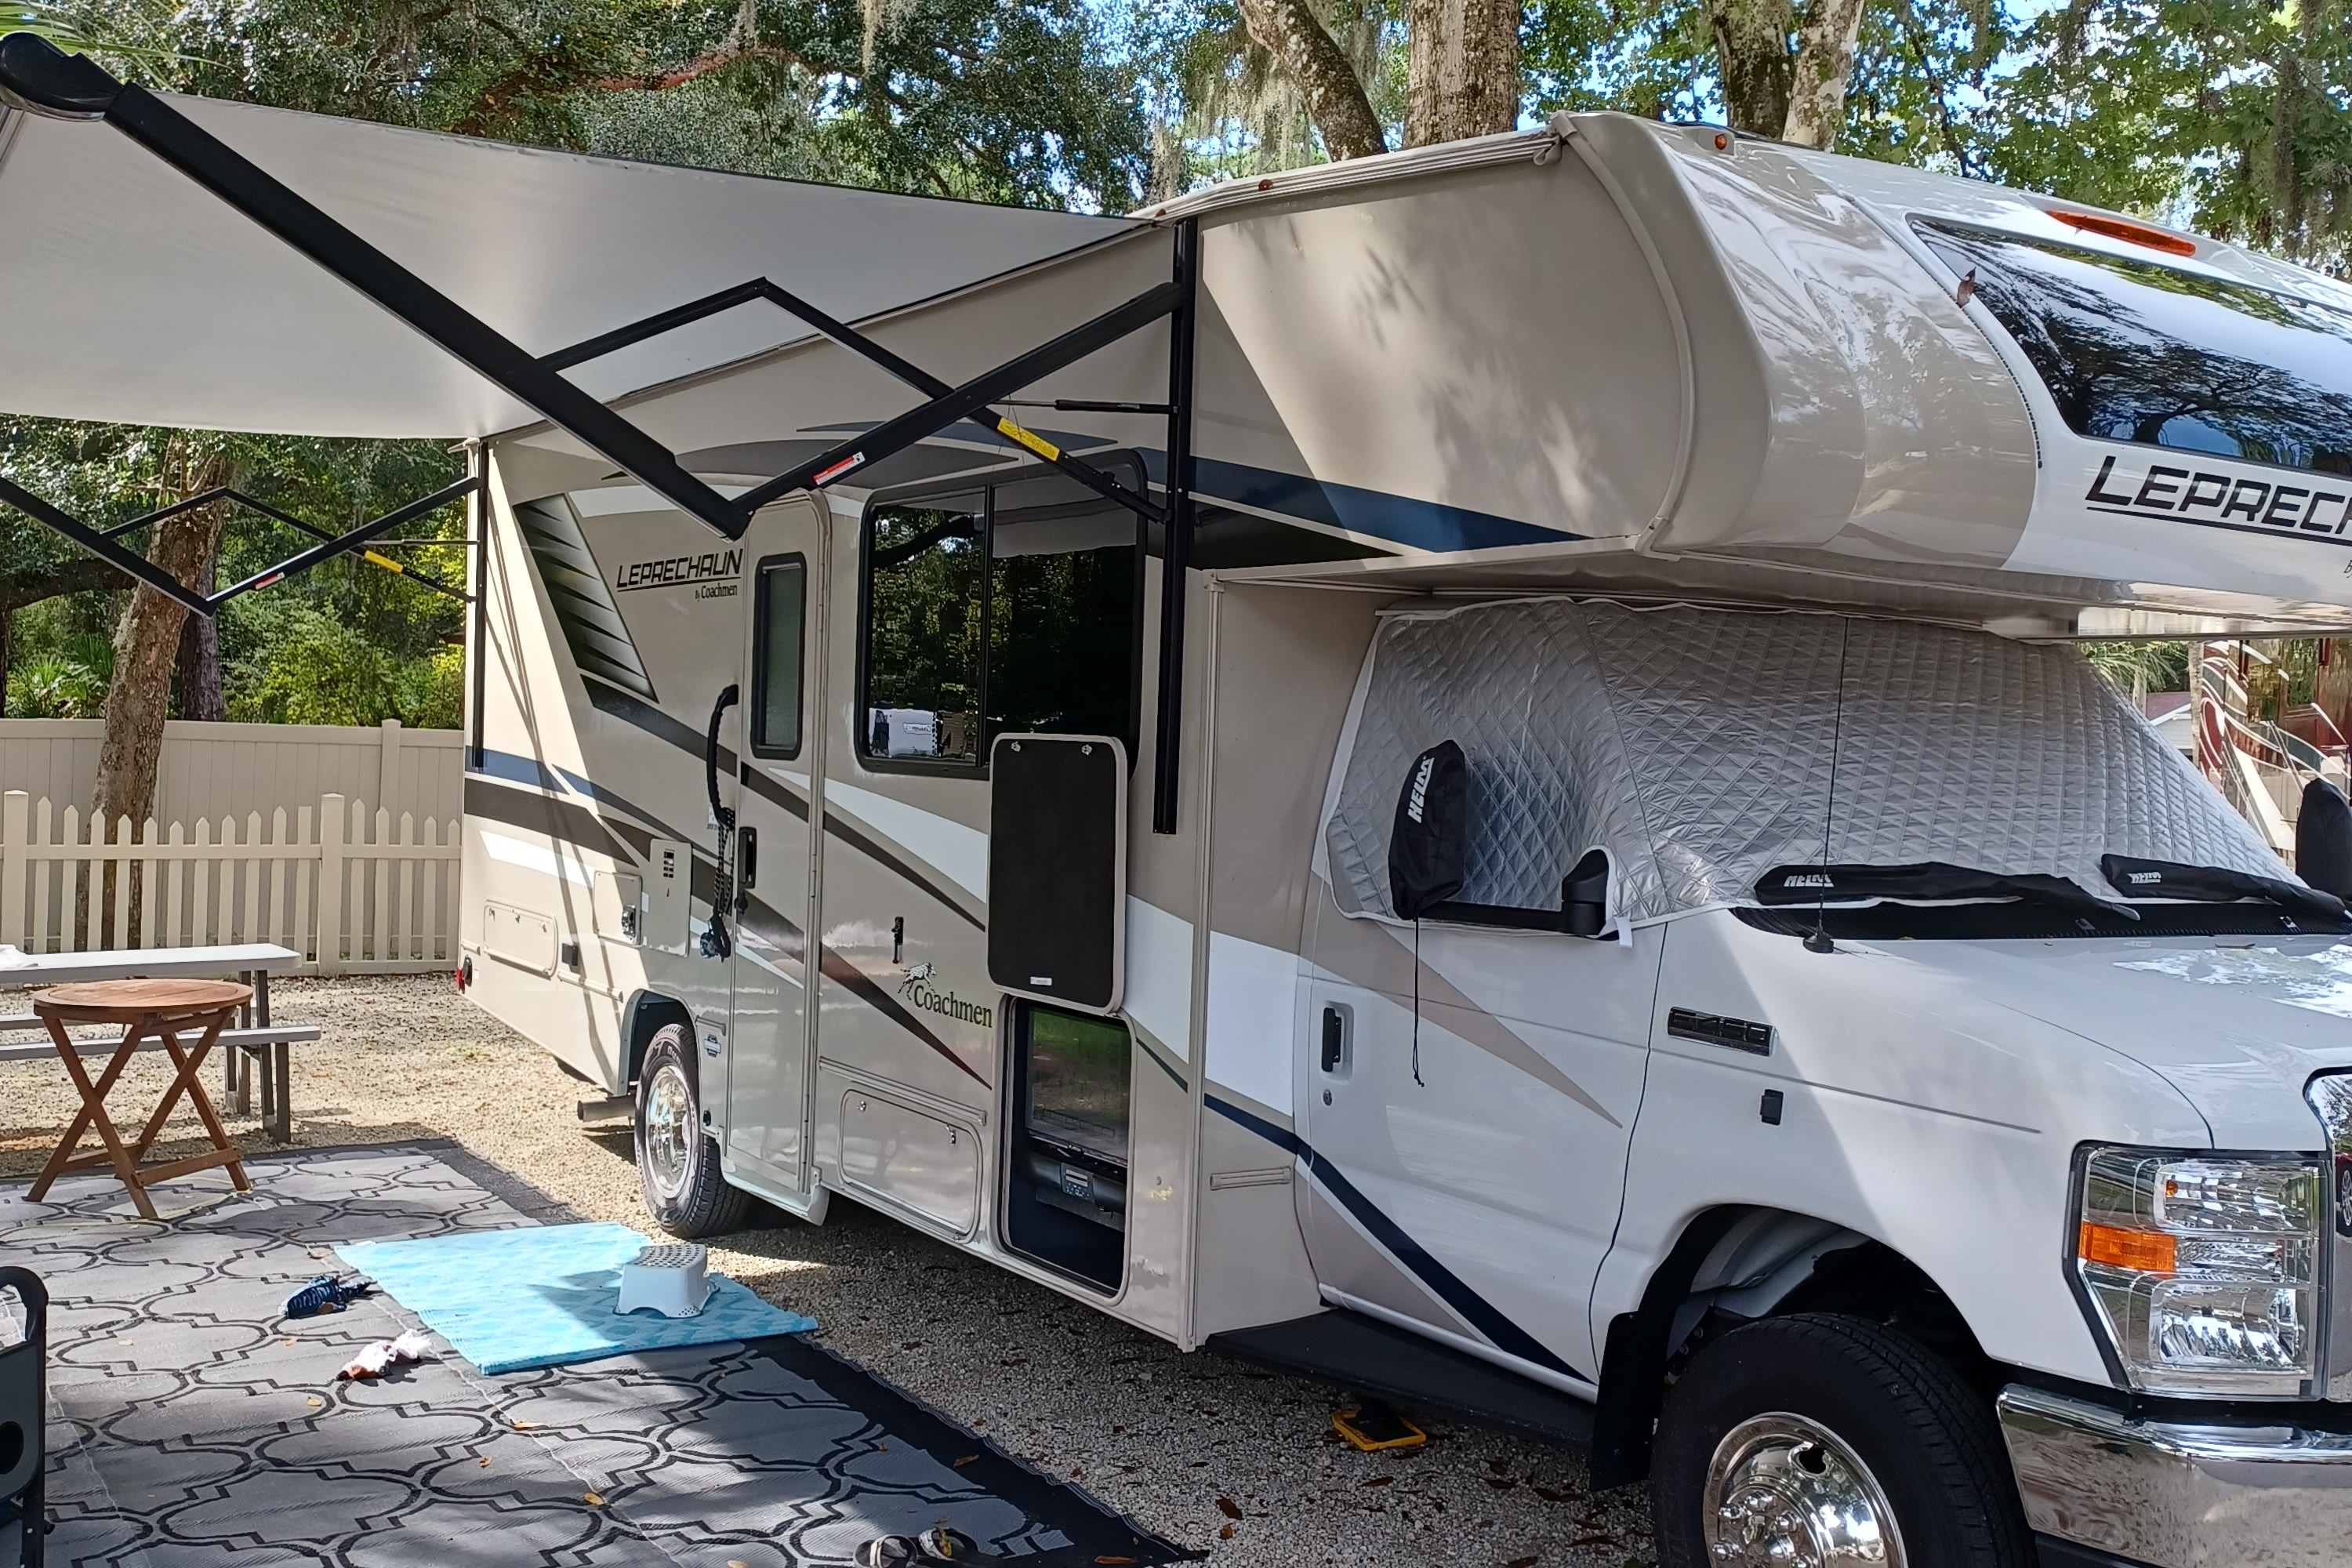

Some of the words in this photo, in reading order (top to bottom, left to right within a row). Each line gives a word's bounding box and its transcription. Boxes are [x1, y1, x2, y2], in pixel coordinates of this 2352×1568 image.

[616, 548, 743, 588] LEPRECHAUN
[701, 583, 738, 599] Coachmen
[1407, 757, 1435, 823] HELM
[913, 985, 993, 1029] Coachmen
